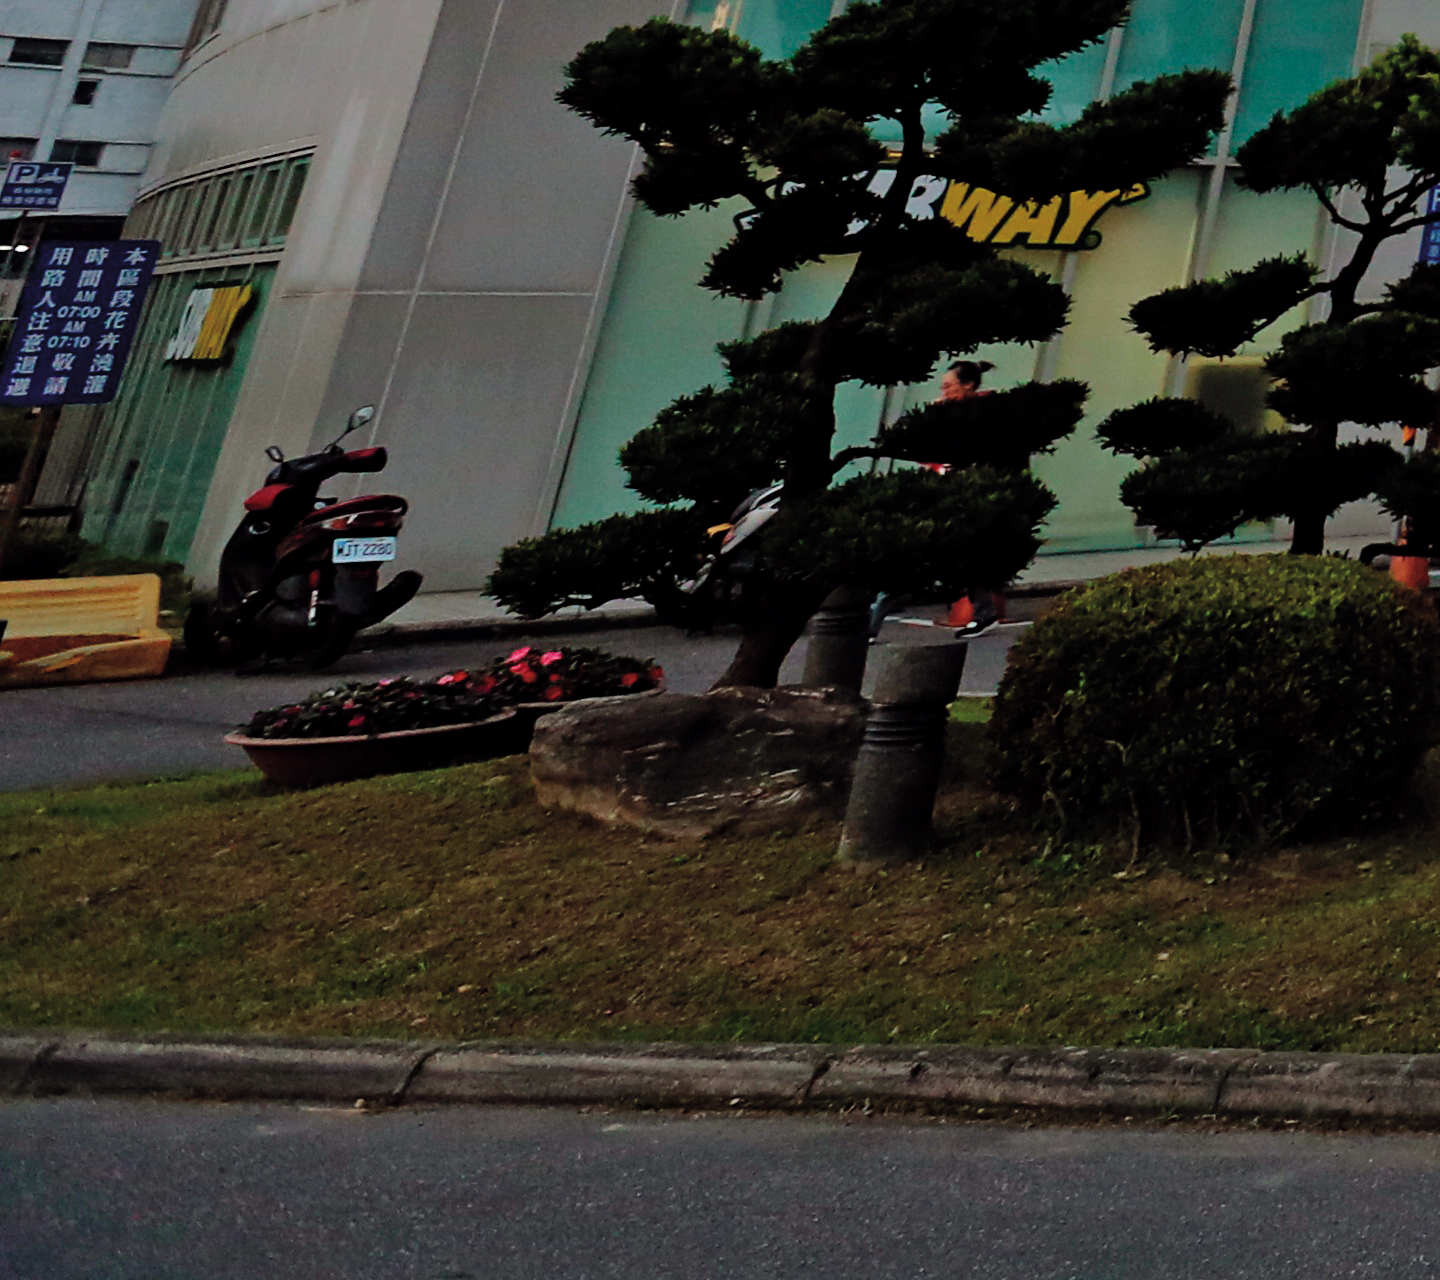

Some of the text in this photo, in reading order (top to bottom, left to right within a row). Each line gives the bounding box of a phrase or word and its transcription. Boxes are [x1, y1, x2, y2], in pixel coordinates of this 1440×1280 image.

[43, 247, 110, 396] 時間 AM 07:00 AM 07:10 敬請
